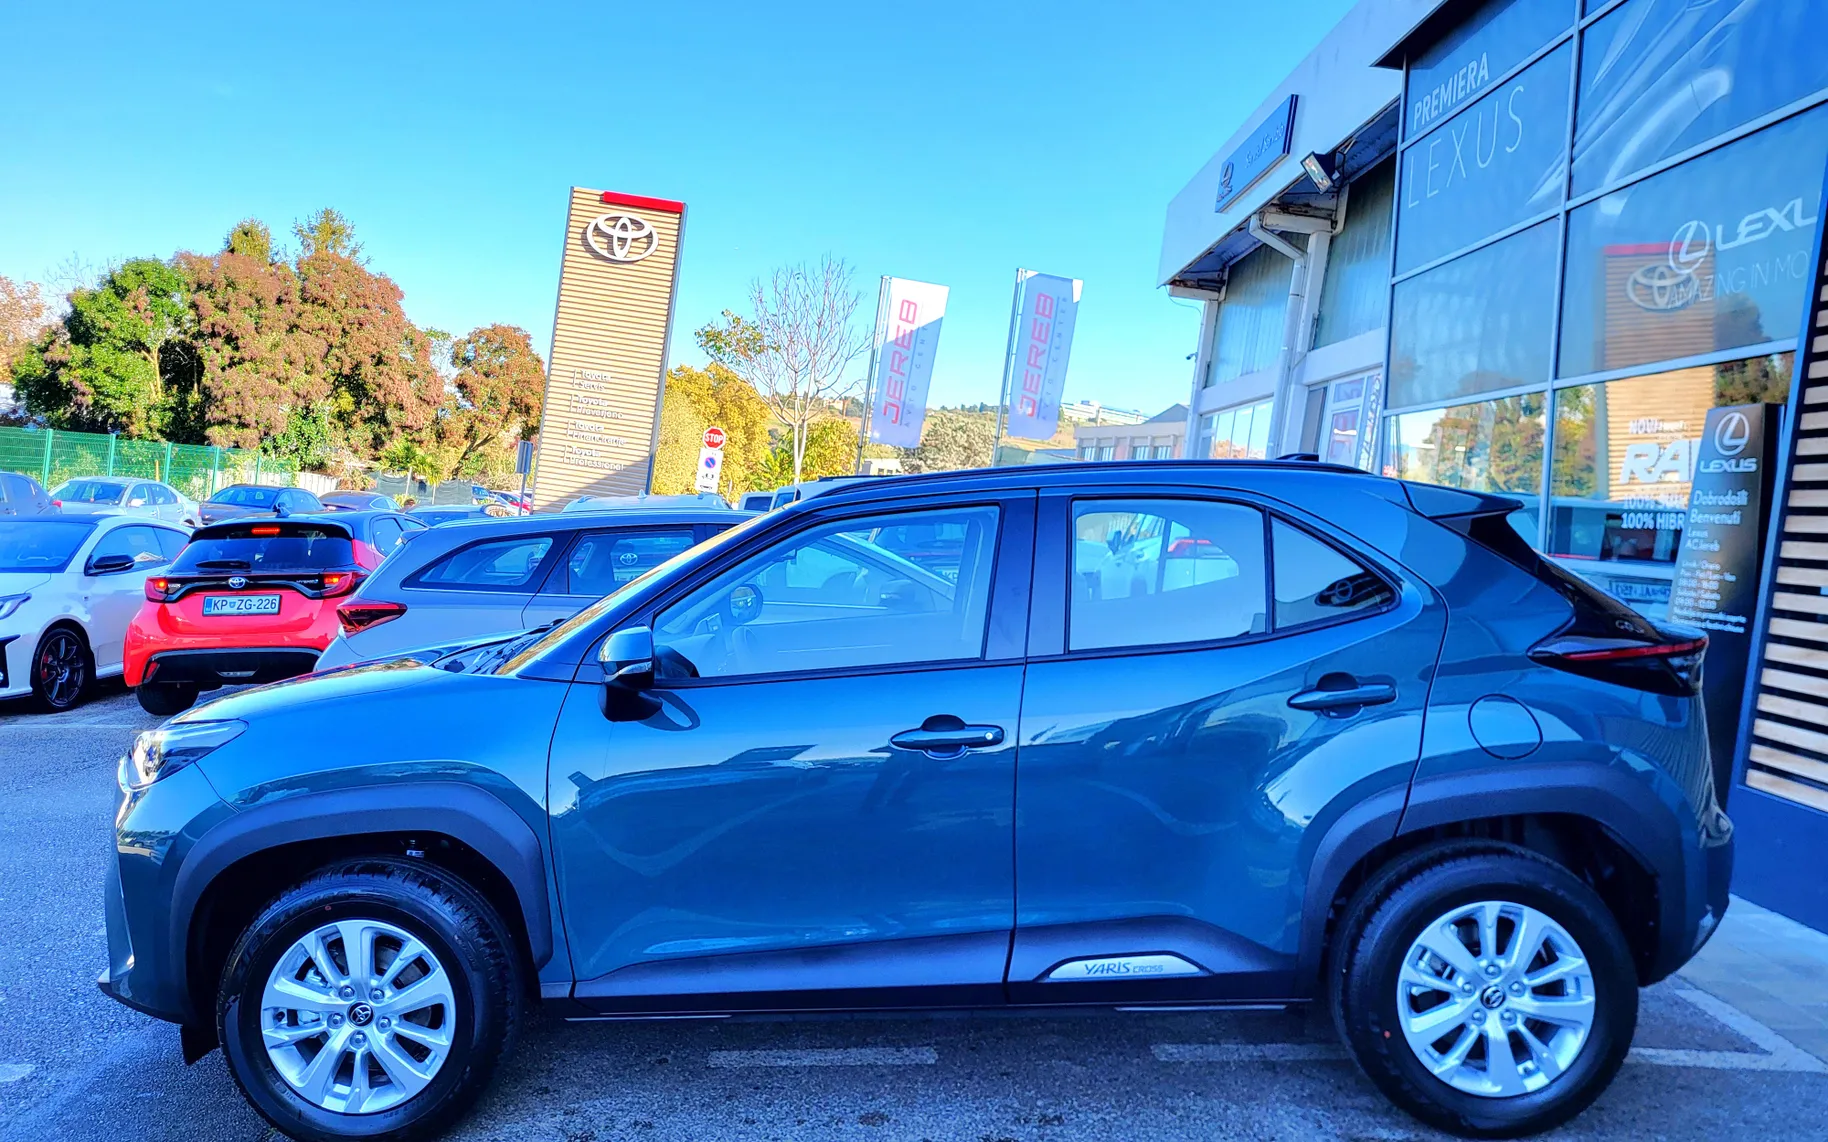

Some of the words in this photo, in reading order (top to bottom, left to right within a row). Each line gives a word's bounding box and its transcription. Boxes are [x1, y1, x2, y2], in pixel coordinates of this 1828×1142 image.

[1413, 52, 1489, 131] PREMIERA
[1407, 86, 1524, 208] LEXUS
[1716, 195, 1819, 251] LEXU
[1775, 250, 1810, 283] MO
[883, 299, 918, 424] JEREB
[1020, 292, 1054, 418] JEREB
[578, 395, 608, 407] Toyota
[705, 433, 723, 443] STOP
[1699, 457, 1758, 473] LEXUS
[1621, 512, 1655, 529] 100%
[1656, 512, 1686, 530] HIBR
[1690, 508, 1741, 525] Benvenuti
[213, 599, 228, 611] KP
[236, 598, 277, 611] ZG-226
[1084, 961, 1131, 975] YARIS
[1132, 964, 1163, 974] CROSS
